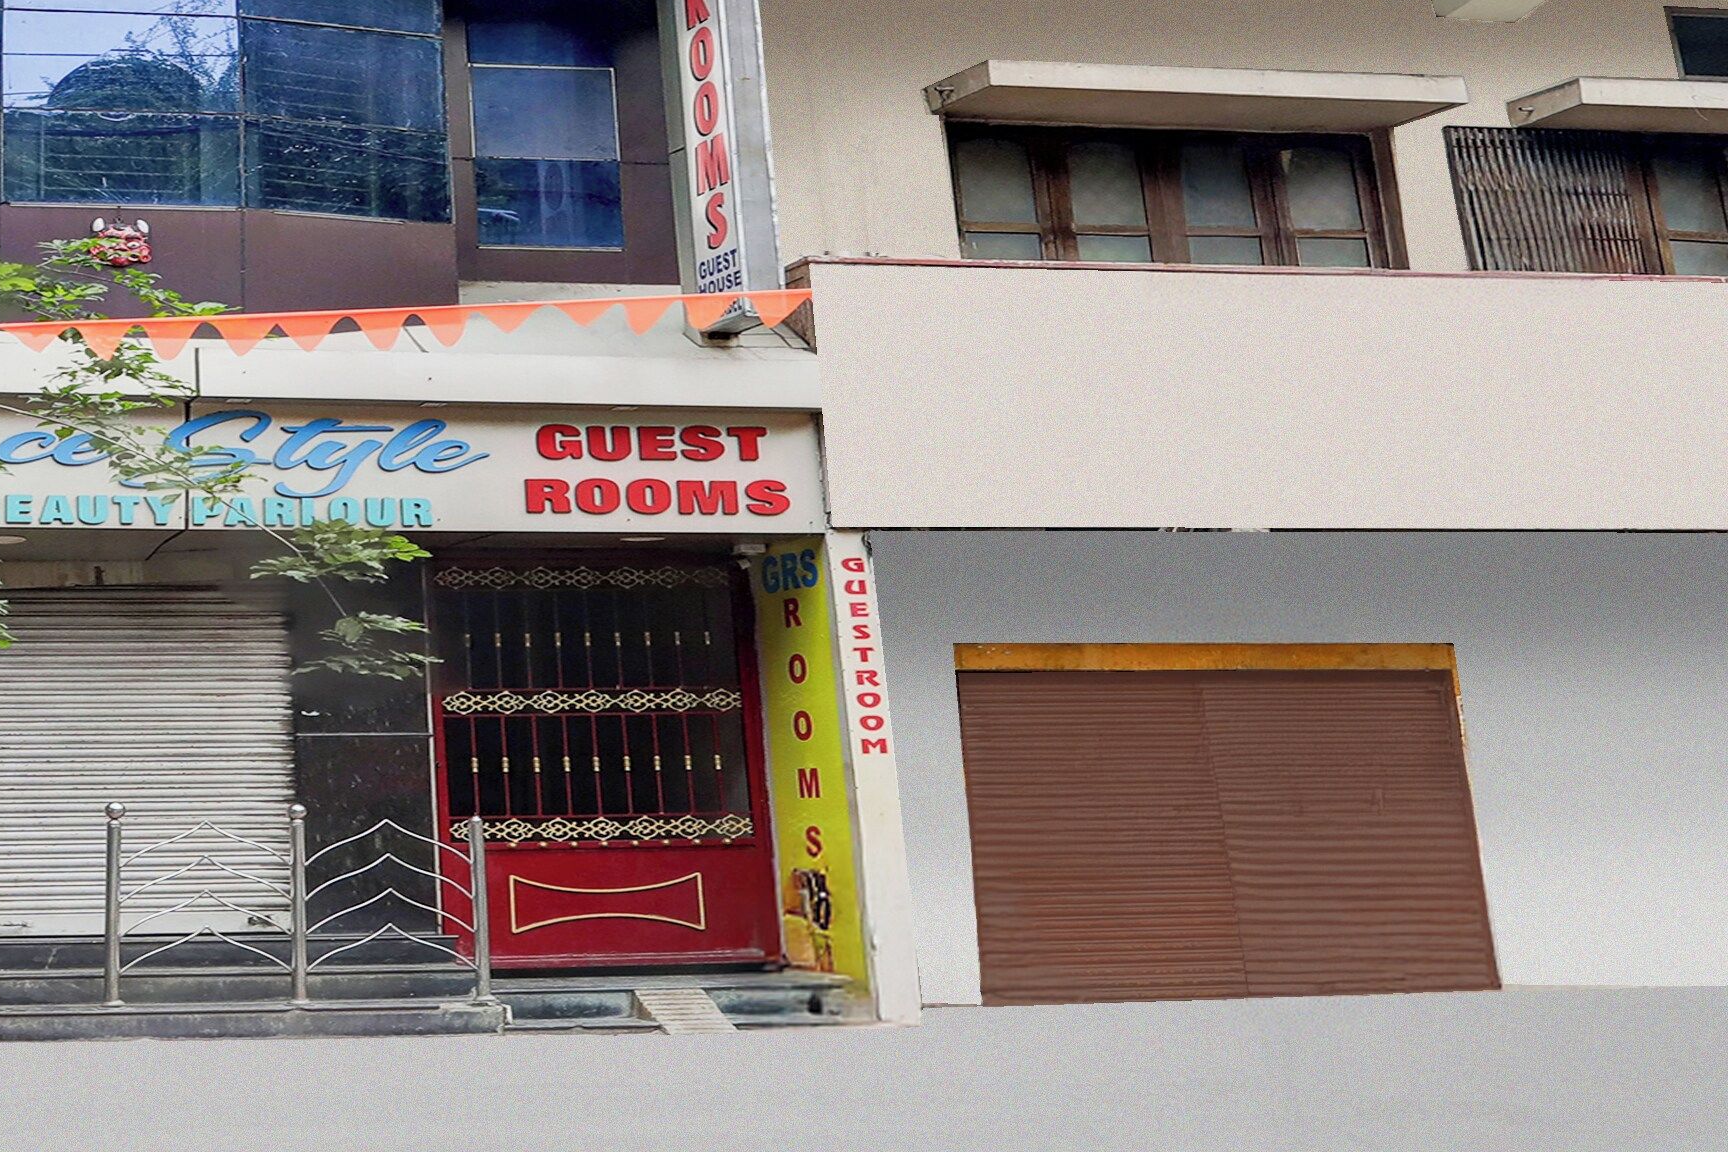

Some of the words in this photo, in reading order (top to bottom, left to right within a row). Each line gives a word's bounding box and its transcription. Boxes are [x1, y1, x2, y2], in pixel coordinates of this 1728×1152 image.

[698, 248, 738, 280] GUEST
[698, 270, 743, 294] HOUSE
[118, 408, 490, 498] Style
[535, 423, 768, 462] GUEST
[191, 497, 434, 528] PARLOUR
[523, 478, 791, 516] ROOMS
[761, 549, 819, 594] GRS
[783, 597, 823, 859] ROOMS
